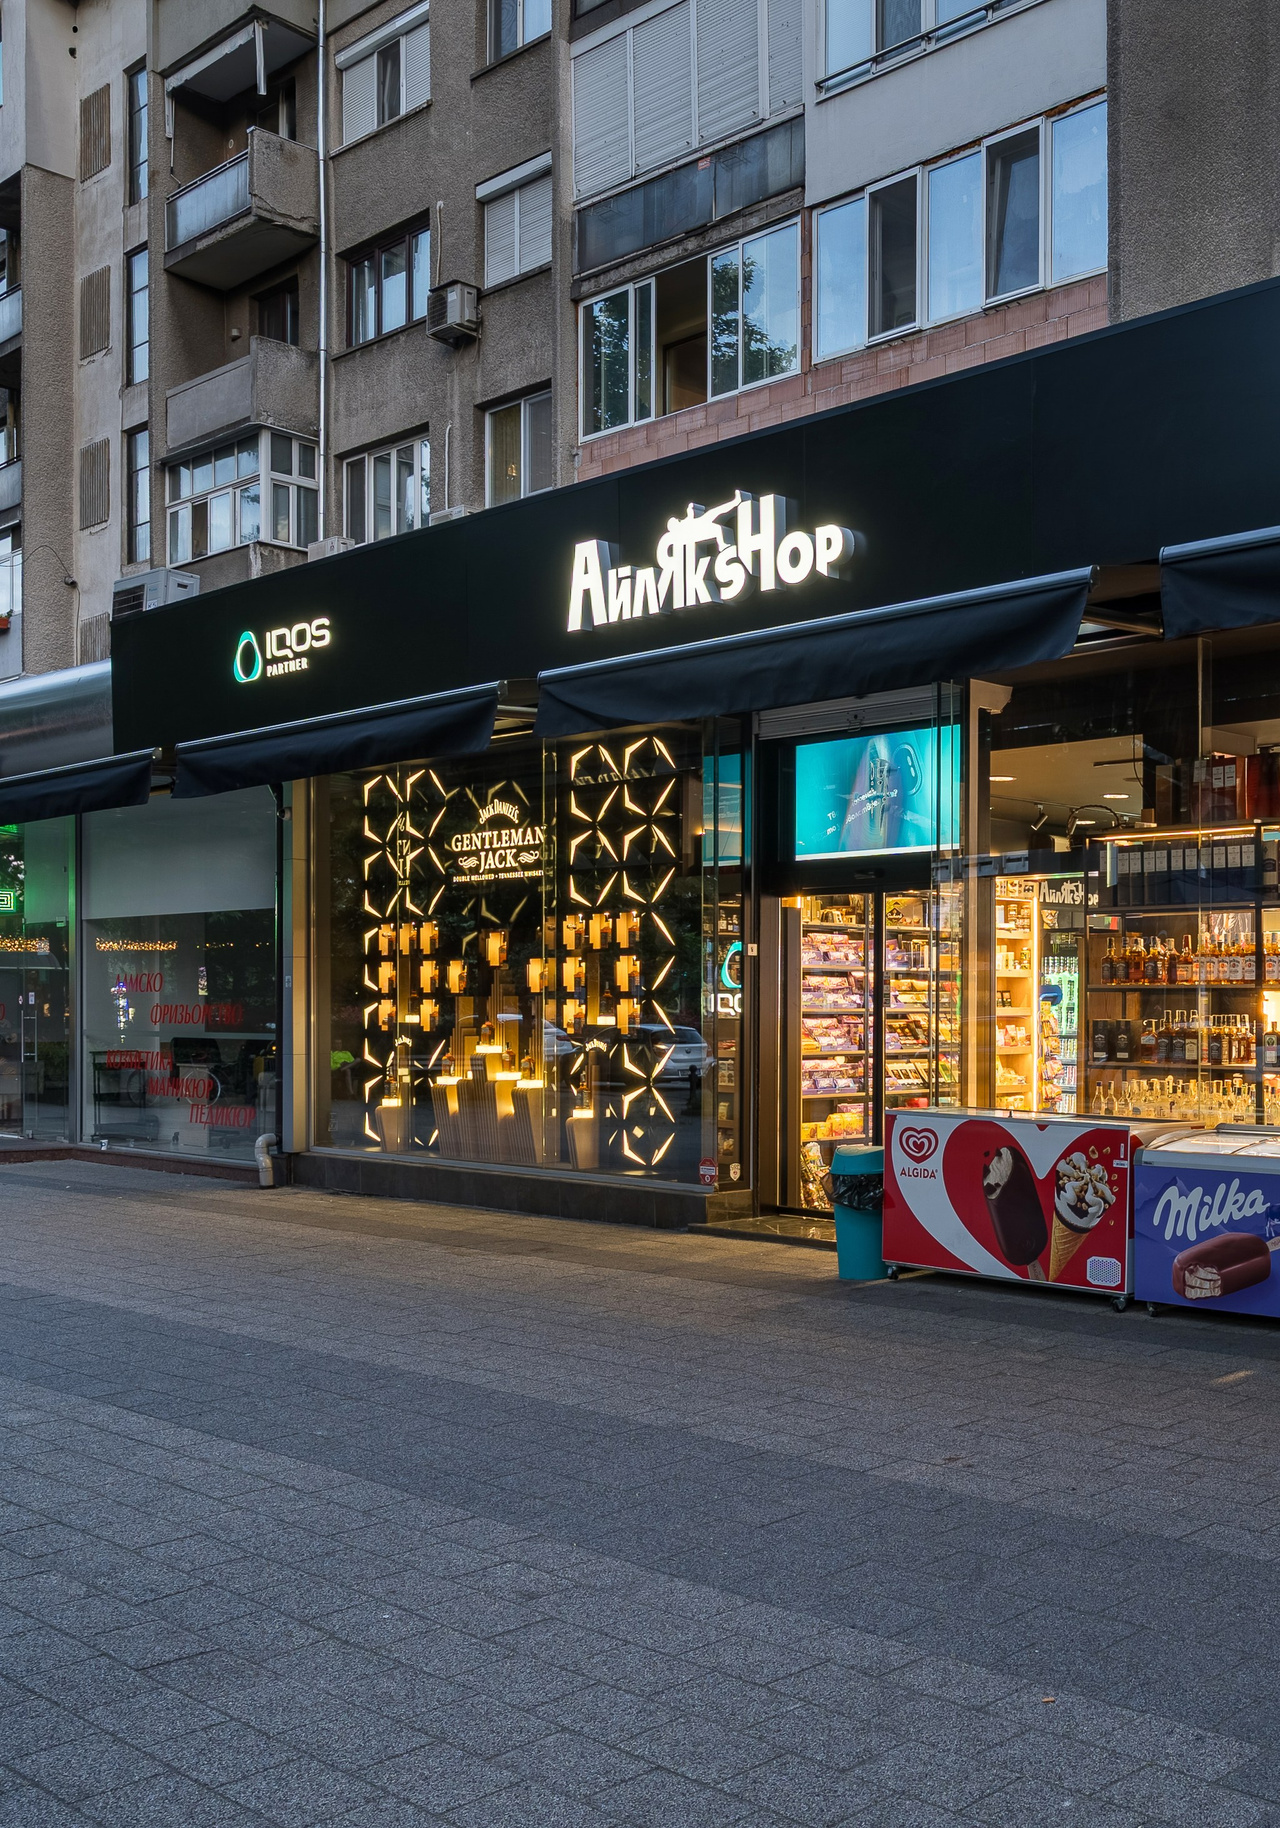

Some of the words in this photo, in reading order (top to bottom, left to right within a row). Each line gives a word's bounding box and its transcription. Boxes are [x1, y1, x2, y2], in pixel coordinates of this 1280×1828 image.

[265, 617, 331, 659] IQOS
[266, 657, 308, 677] PARTNER
[451, 826, 547, 852] GENTLEMAN
[479, 849, 519, 873] JACK
[900, 1166, 937, 1179] ALGIDA
[1152, 1177, 1271, 1242] Milka
